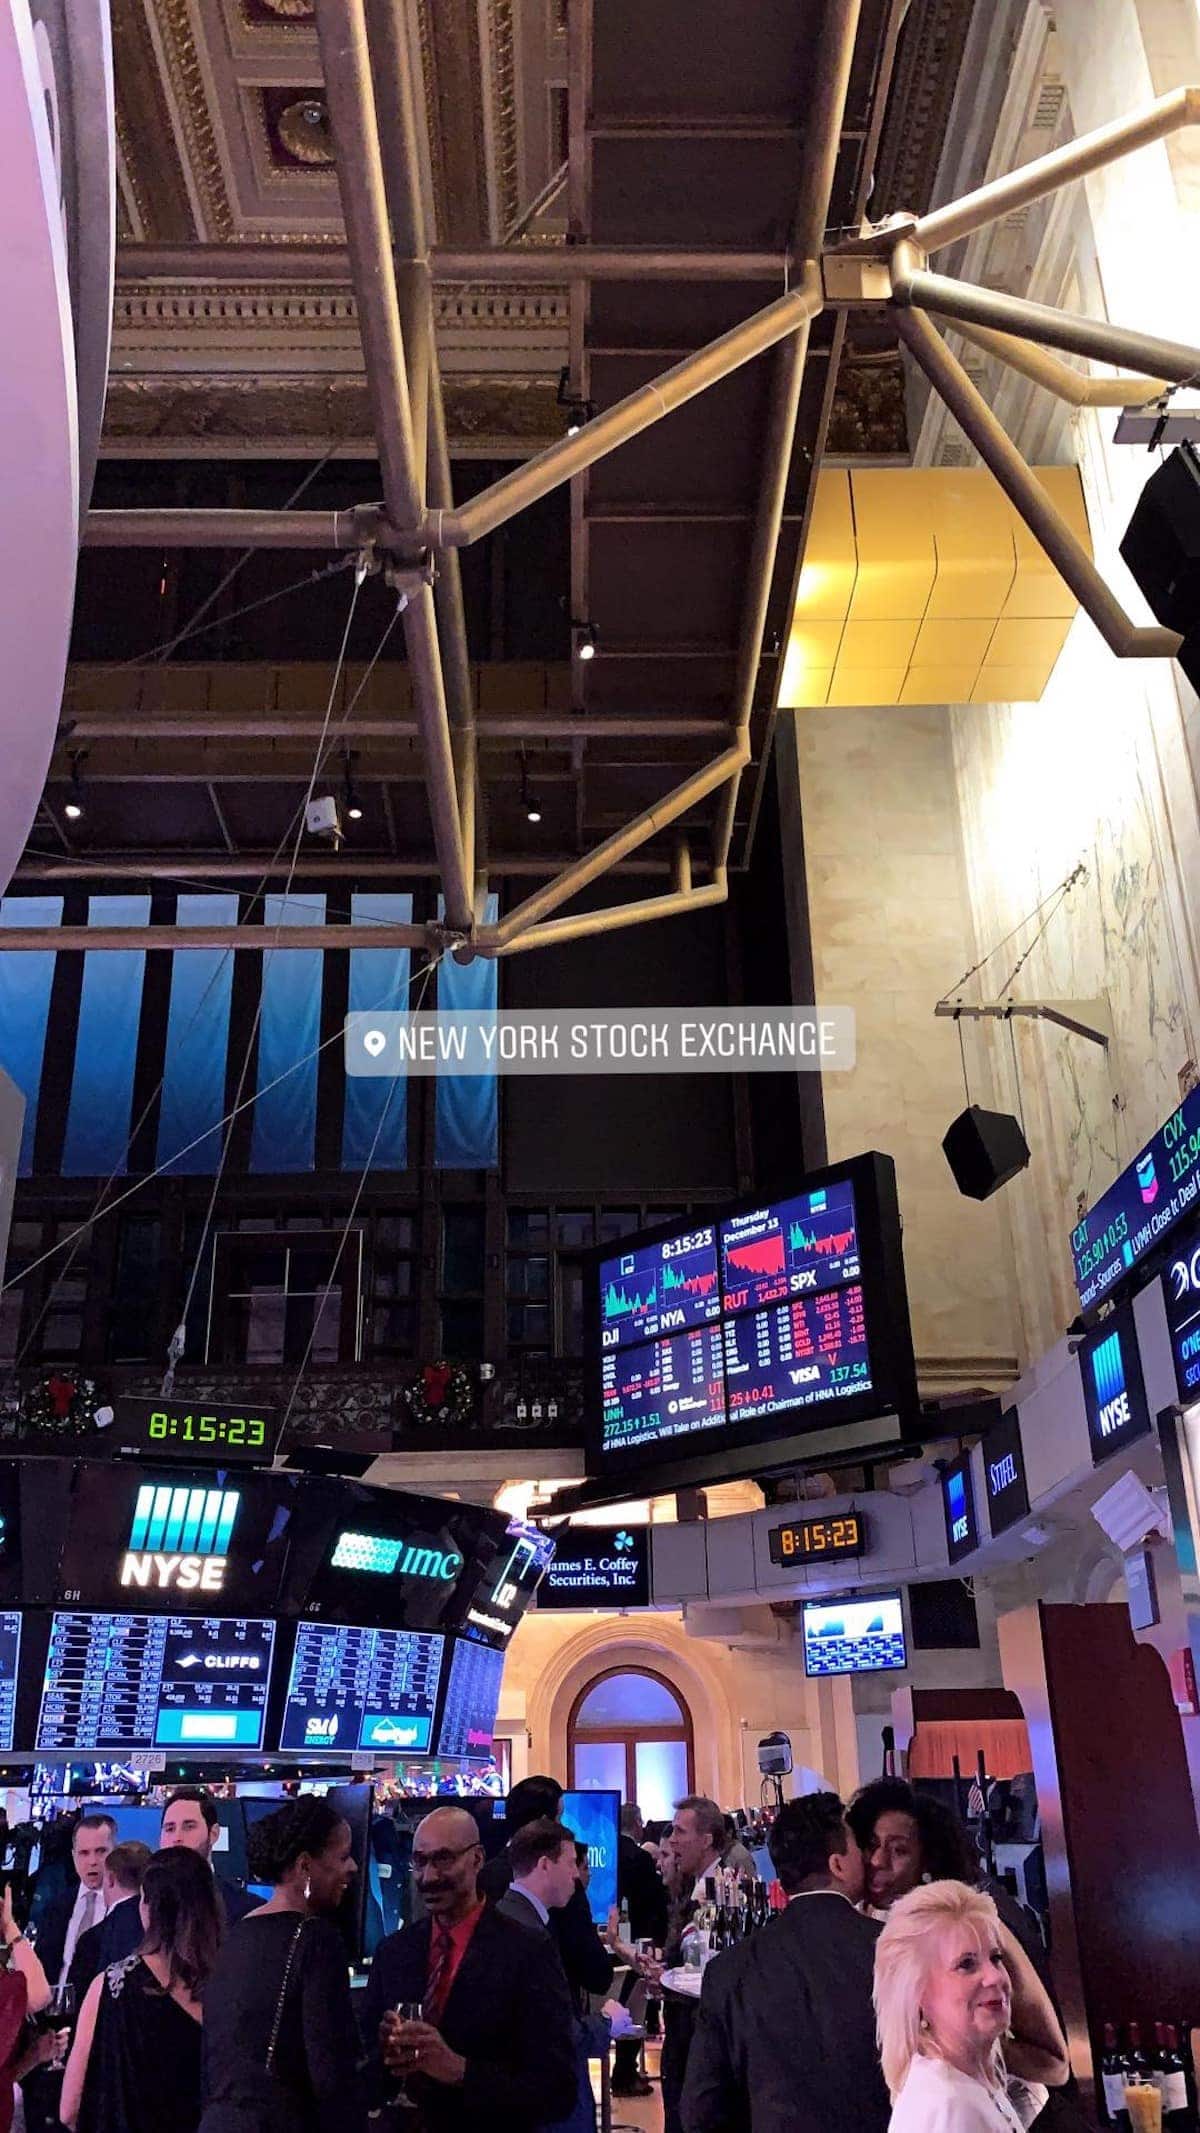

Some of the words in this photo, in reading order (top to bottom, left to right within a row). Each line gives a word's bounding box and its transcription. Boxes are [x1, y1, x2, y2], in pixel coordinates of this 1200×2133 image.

[1164, 1108, 1186, 1149] CVX
[731, 1209, 769, 1228] Thursday
[1132, 1223, 1152, 1255] LVMH
[1151, 1208, 1172, 1235] Close
[1178, 1175, 1198, 1208] Deal
[723, 1224, 766, 1243] December
[768, 1218, 779, 1229] 13
[1072, 1219, 1090, 1251] CAT
[662, 1229, 713, 1259] 8:15:23
[790, 1270, 817, 1291] SPX
[723, 1289, 749, 1311] RUT
[660, 1309, 686, 1329] NYA
[602, 1328, 619, 1346] DJI
[828, 1352, 838, 1366] V
[789, 1365, 821, 1384] VISA
[830, 1362, 868, 1383] 137.54
[674, 1421, 690, 1434] Take
[740, 1406, 757, 1419] Role
[757, 1403, 767, 1414] of
[767, 1396, 804, 1411] Chairman
[805, 1391, 814, 1403] of
[814, 1388, 835, 1401] HNA
[835, 1380, 873, 1396] Logistics
[1100, 1392, 1131, 1437] NYSE
[149, 1412, 265, 1446] 8:15:23
[990, 1453, 1018, 1496] STIFEL
[781, 1519, 858, 1555] 8:15:23
[952, 1515, 968, 1543] NYSE
[120, 1552, 227, 1591] NYSE
[584, 1558, 597, 1571] E.
[600, 1557, 639, 1574] Coffey
[549, 1573, 611, 1588] Securities,
[613, 1573, 636, 1585] Inc.
[204, 1655, 260, 1669] CLIFFS
[306, 1718, 330, 1735] SM
[135, 1755, 162, 1765] 2726
[587, 1846, 607, 1868] mc
